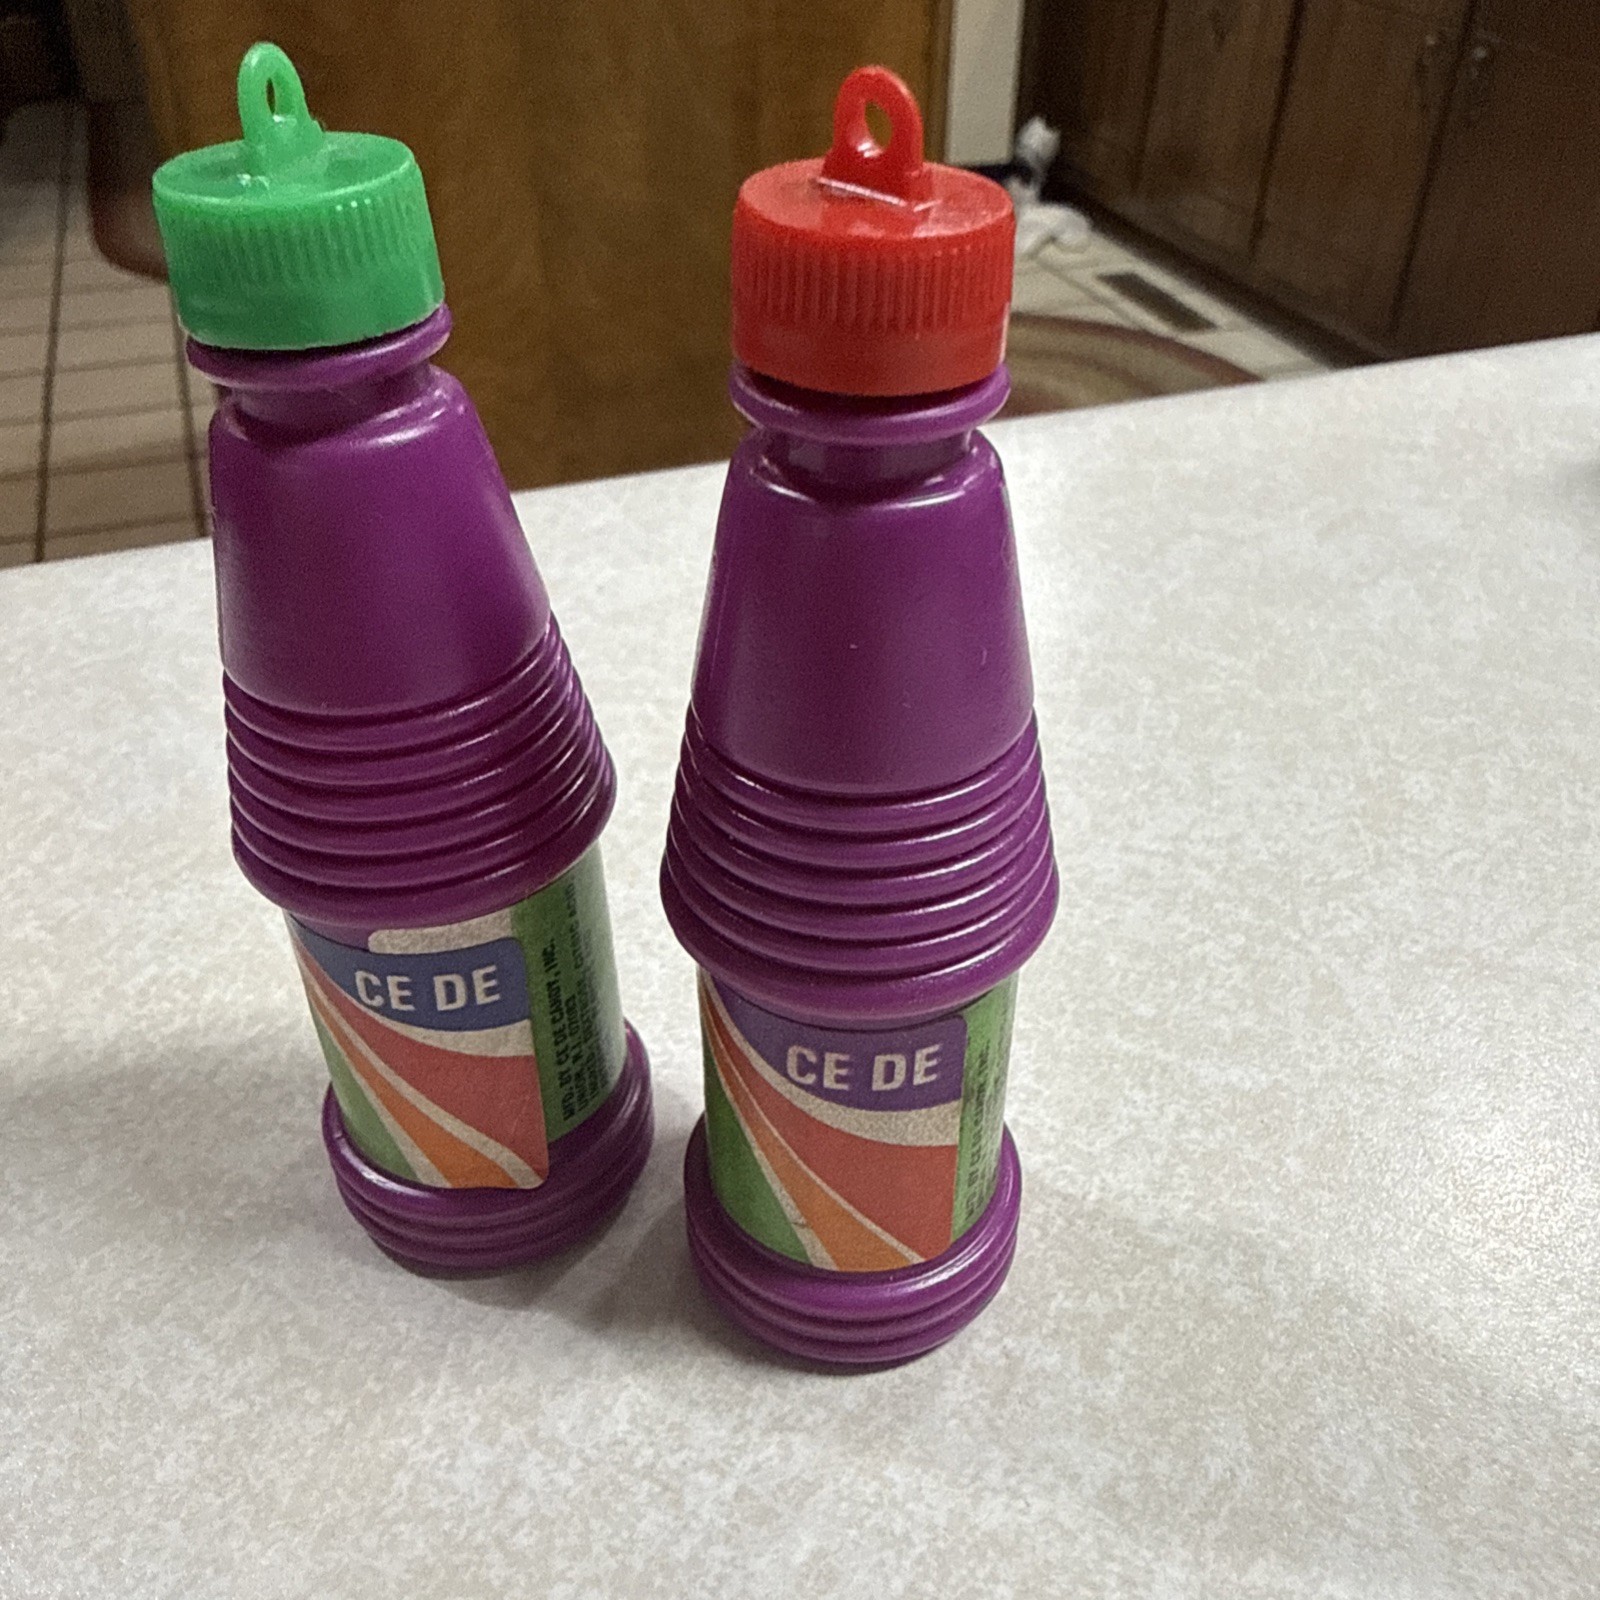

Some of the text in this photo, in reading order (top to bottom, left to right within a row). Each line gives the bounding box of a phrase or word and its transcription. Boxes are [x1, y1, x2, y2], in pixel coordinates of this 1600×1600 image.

[542, 938, 558, 973] INC.
[355, 964, 501, 1012] CE DE
[552, 1023, 567, 1046] DE
[555, 1044, 569, 1065] CE
[786, 1043, 944, 1092] CE DE
[558, 1067, 572, 1088] BY
